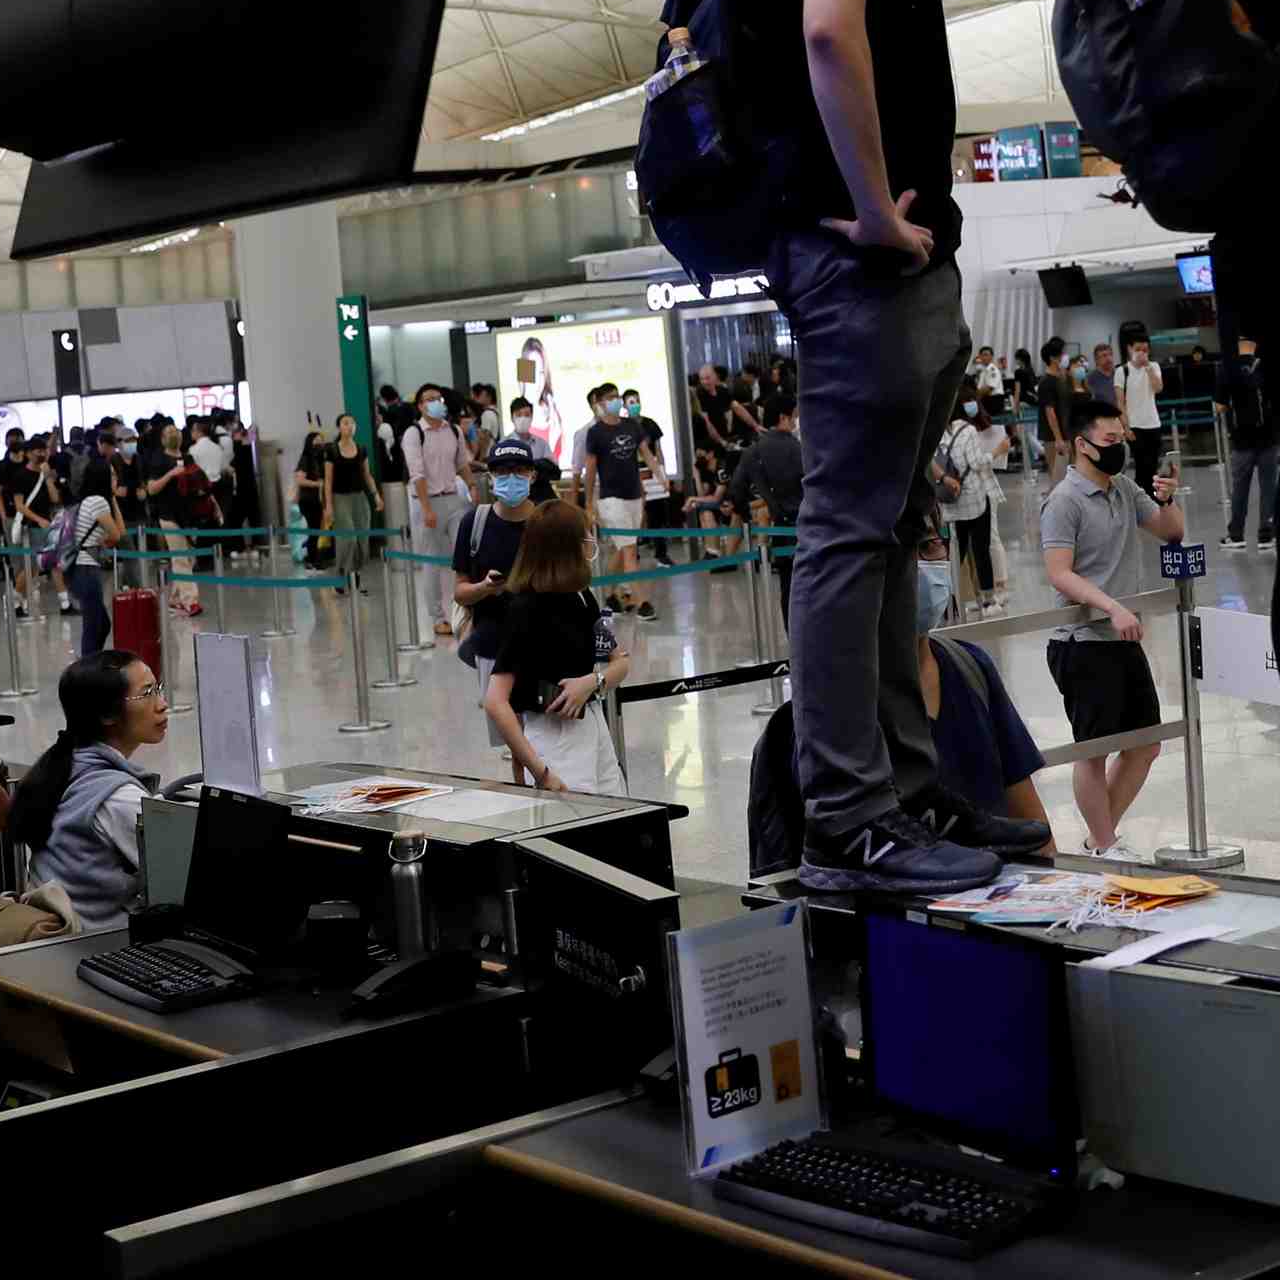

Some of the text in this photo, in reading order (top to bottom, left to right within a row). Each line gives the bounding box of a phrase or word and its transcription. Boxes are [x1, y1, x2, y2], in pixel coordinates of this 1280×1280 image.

[1163, 551, 1182, 564] 出口
[1187, 550, 1203, 563] 出口
[1165, 564, 1180, 575] Out
[1189, 564, 1201, 574] Out
